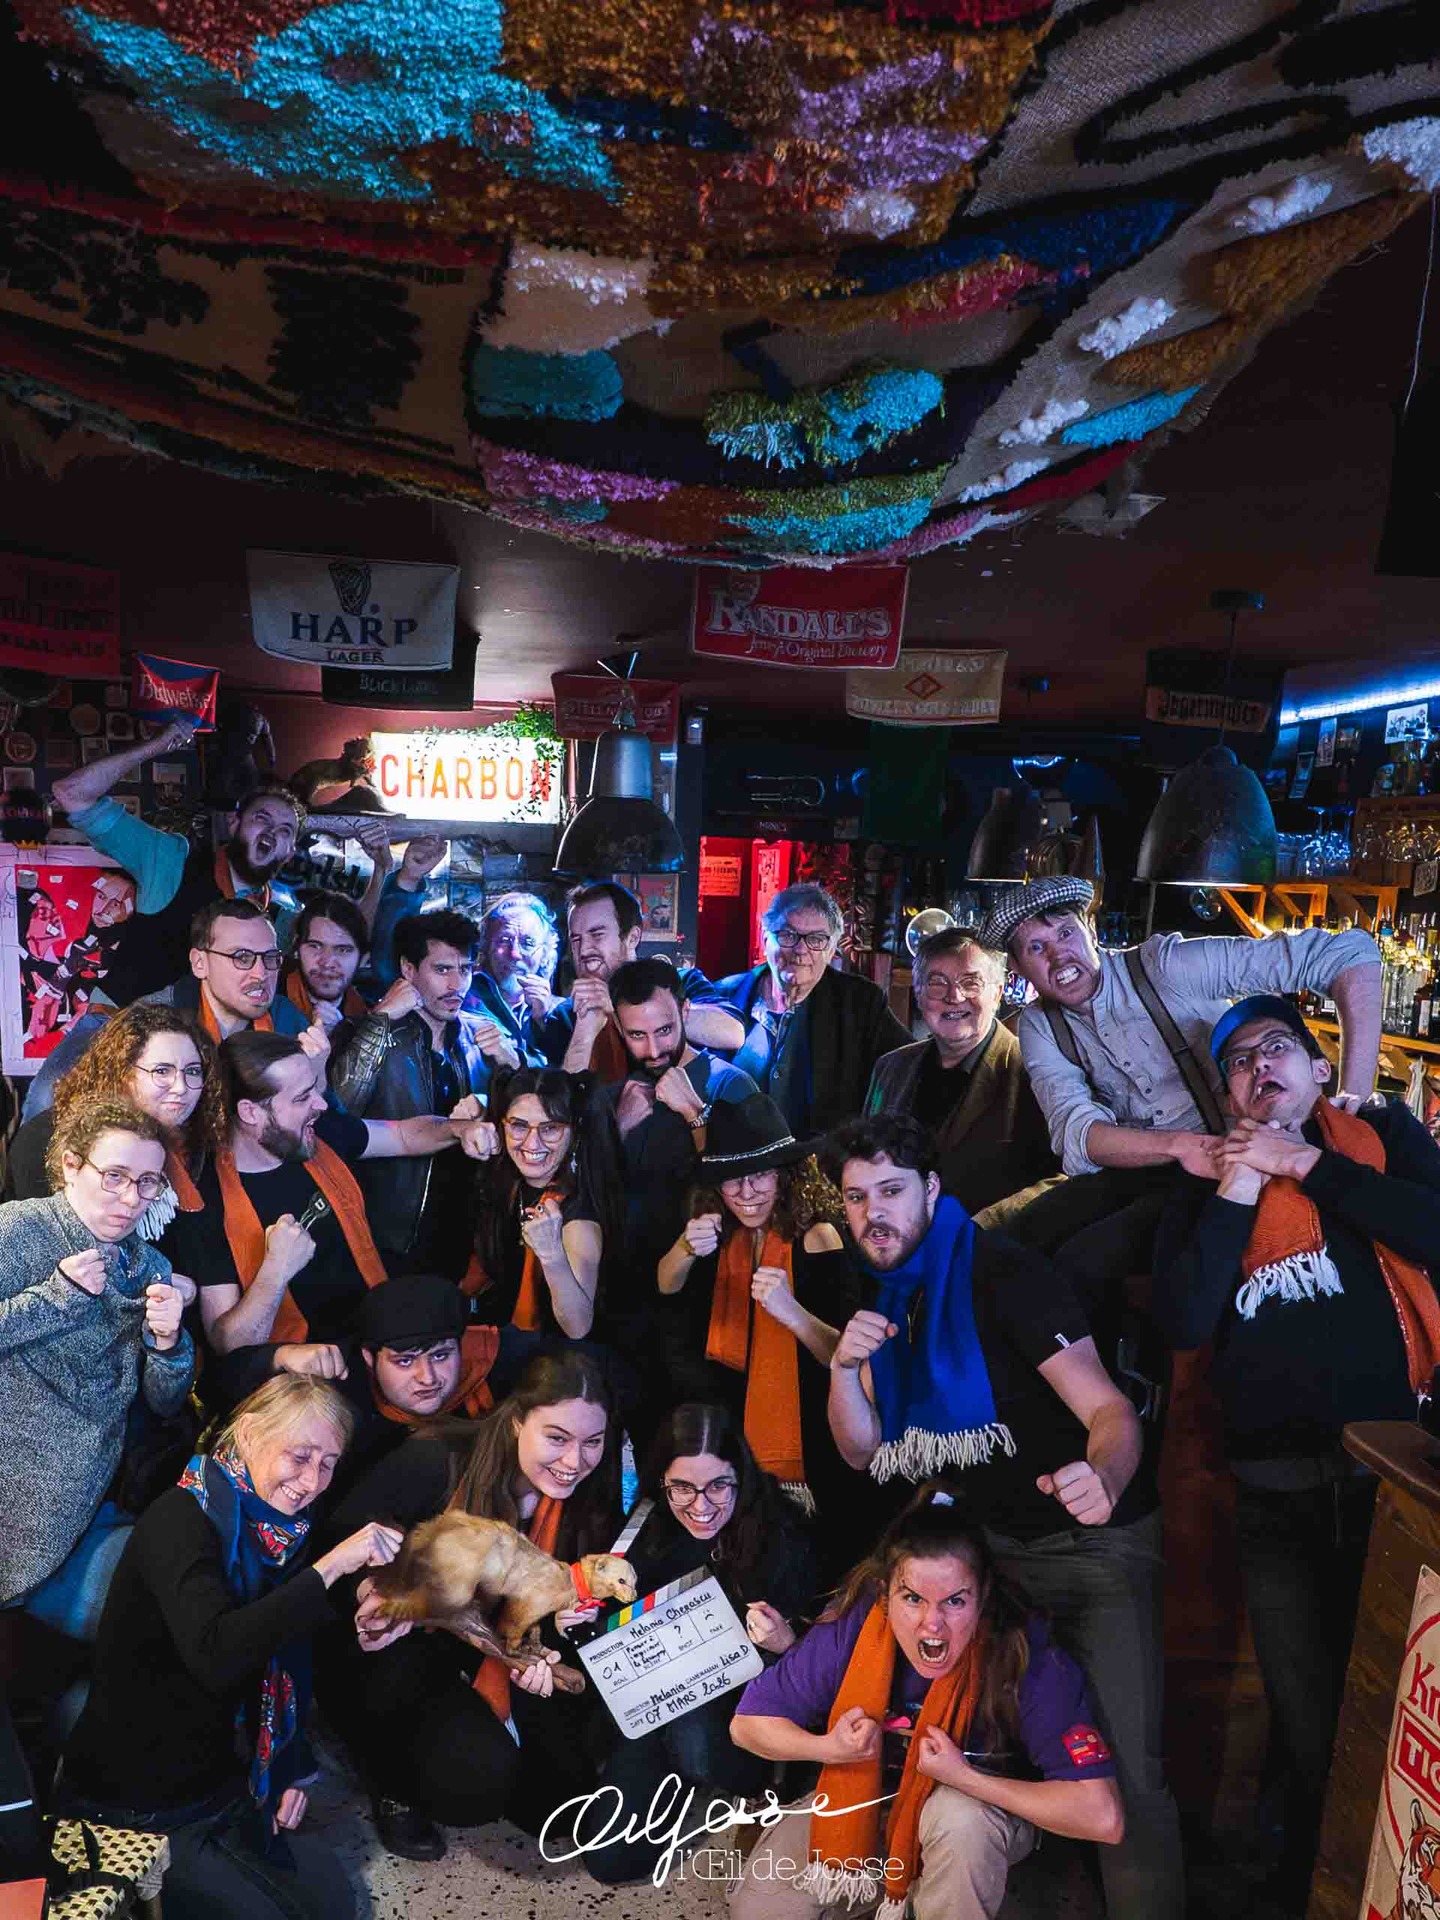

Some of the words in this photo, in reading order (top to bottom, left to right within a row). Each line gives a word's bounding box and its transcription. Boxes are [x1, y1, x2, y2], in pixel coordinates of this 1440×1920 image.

[289, 611, 419, 647] HARP
[707, 585, 891, 642] RANDALL'S
[327, 651, 384, 662] LAGER
[380, 754, 551, 801] CHARBON
[589, 1641, 624, 1662] PRODUCTION
[603, 1661, 622, 1680] 01
[1407, 1652, 1440, 1727] Kr
[645, 1706, 662, 1724] 07
[666, 1691, 697, 1713] MARS
